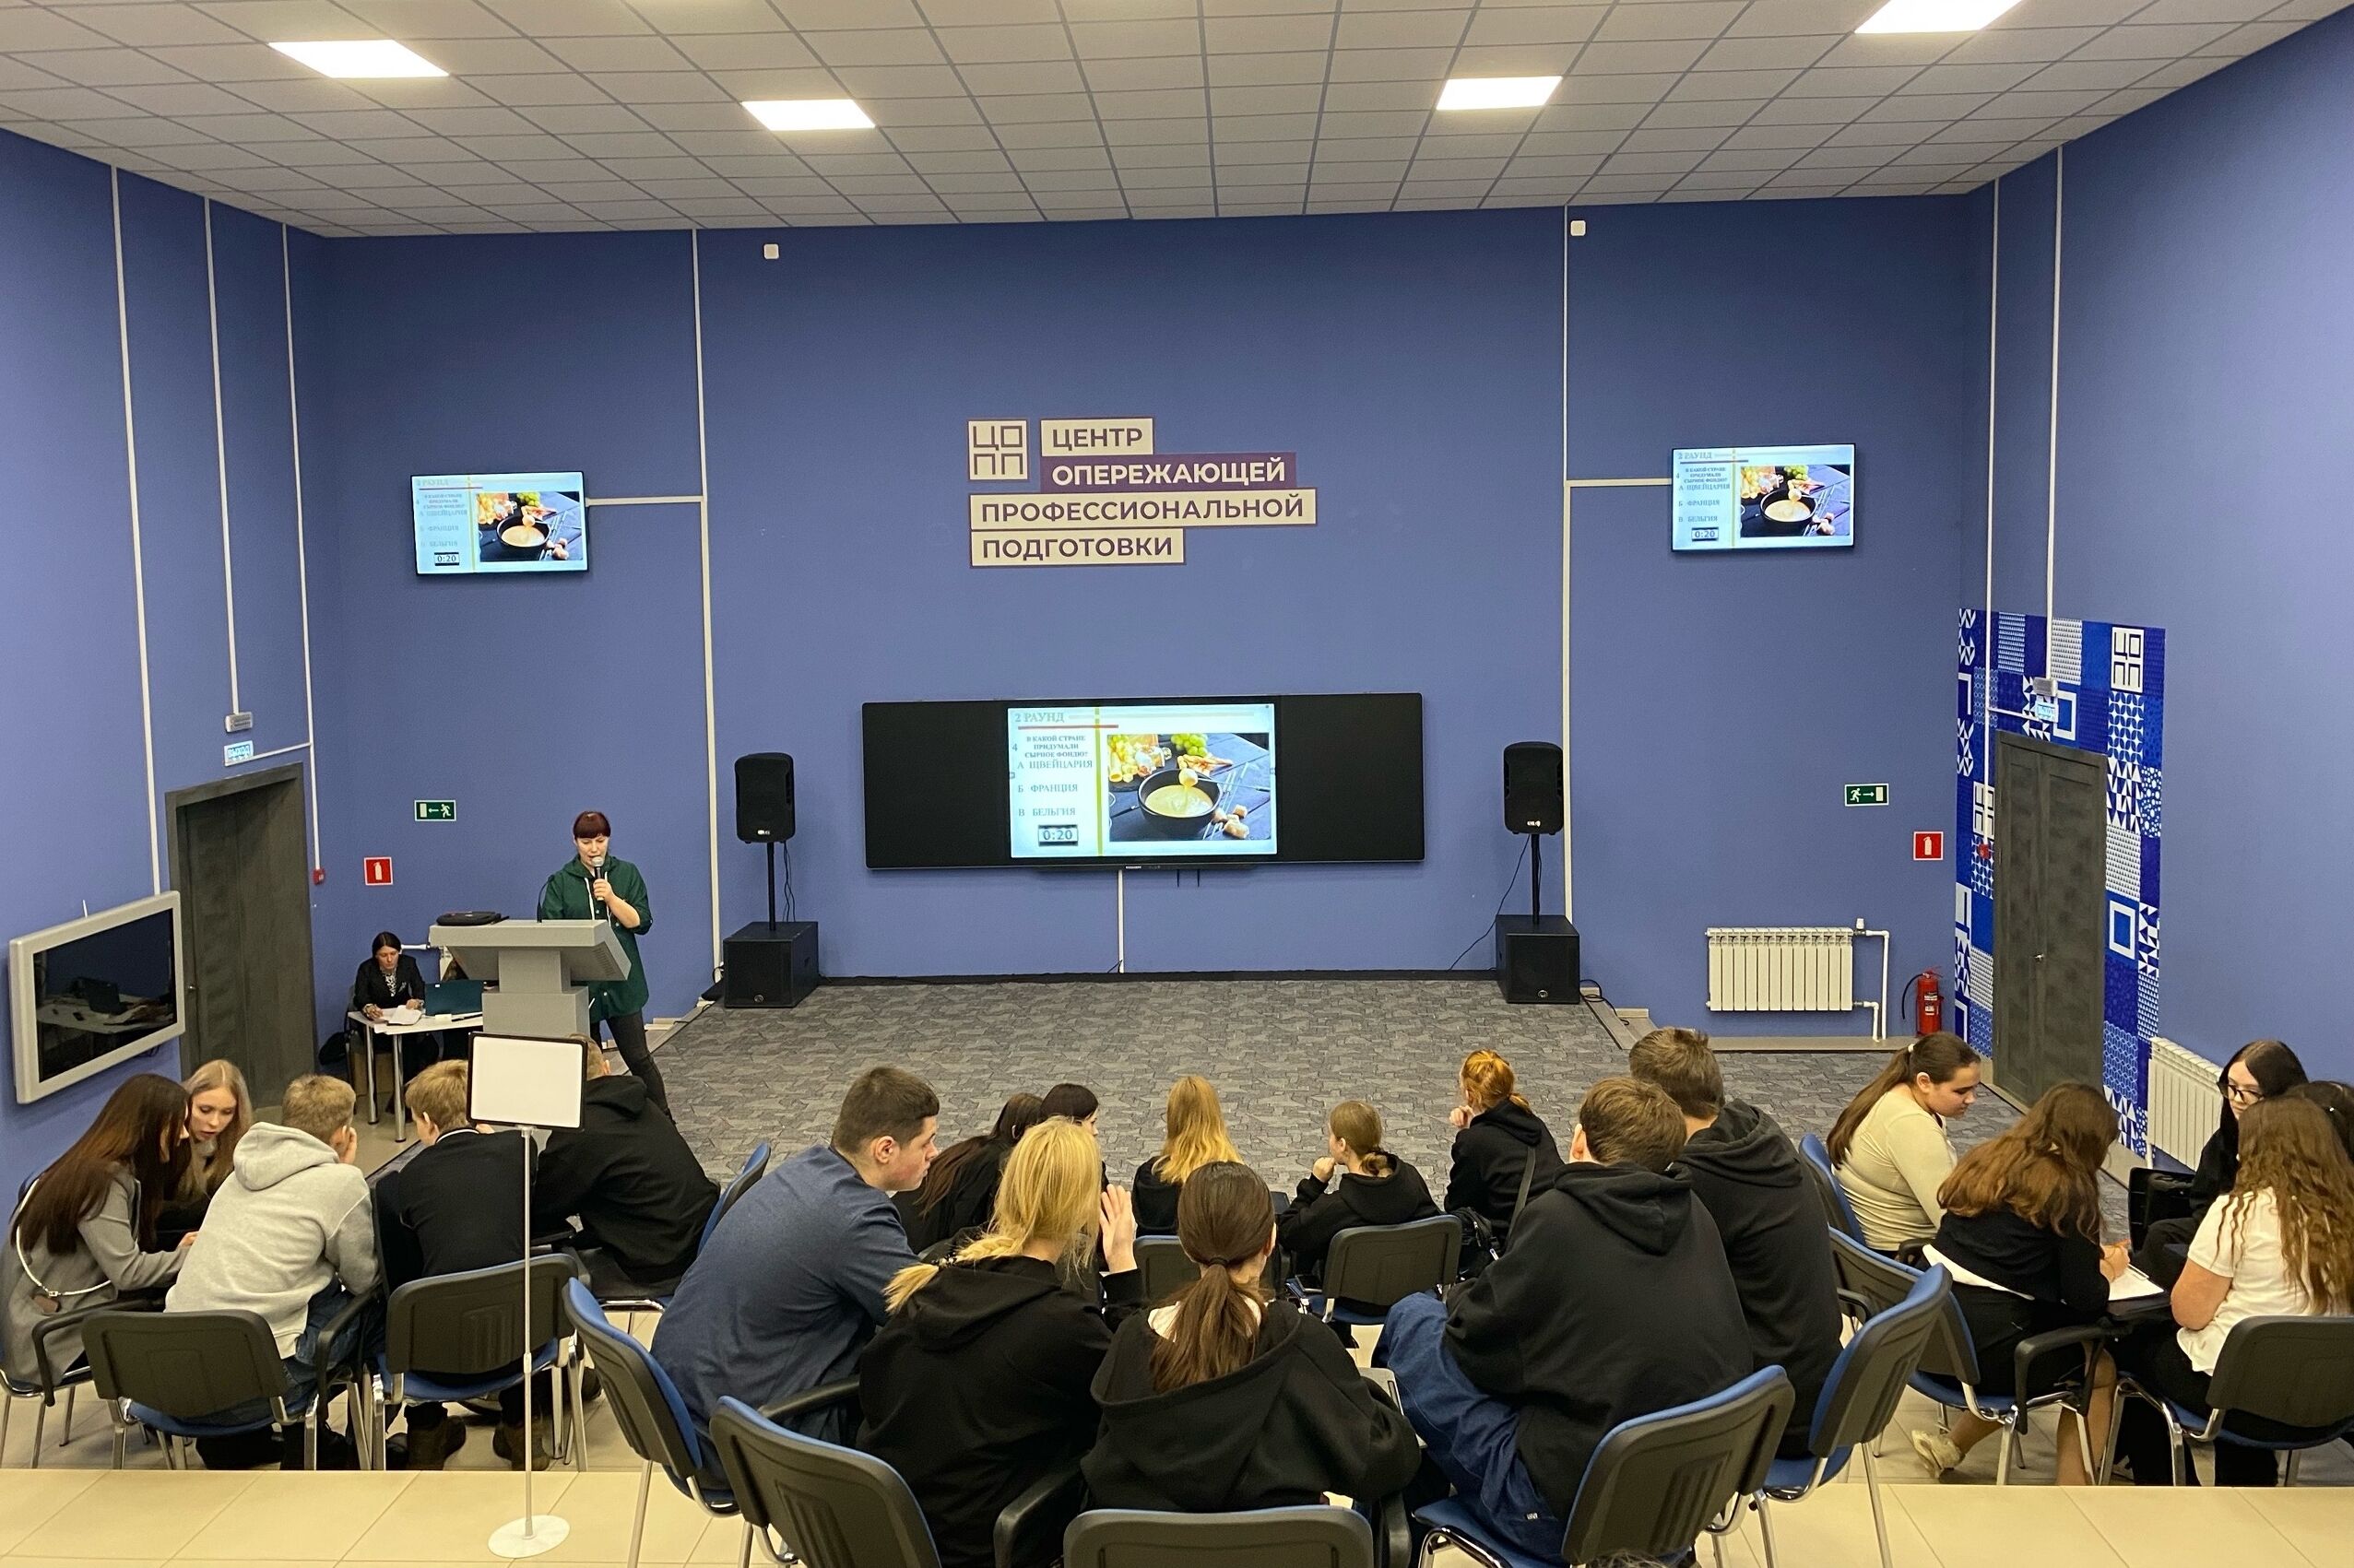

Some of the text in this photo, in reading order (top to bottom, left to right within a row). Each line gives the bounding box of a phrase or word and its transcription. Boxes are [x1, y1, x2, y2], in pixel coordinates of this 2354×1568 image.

[1052, 428, 1142, 451] ЦЕНТР
[1052, 457, 1285, 486] ОПЕРЕЖАЮЩЕЙ
[982, 493, 1303, 522] ПРОФЕССИОНАЛЬНОЙ
[983, 537, 1172, 560] ПОДГОТОВКИ
[1015, 712, 1065, 723] 2 РАУНД
[1011, 743, 1018, 751] 4
[1017, 760, 1024, 769] А
[1017, 784, 1078, 793] Б ФРАНЦИЯ
[1018, 808, 1076, 817] В БЕЛЬГИЯ
[1042, 830, 1073, 840] 0:20
